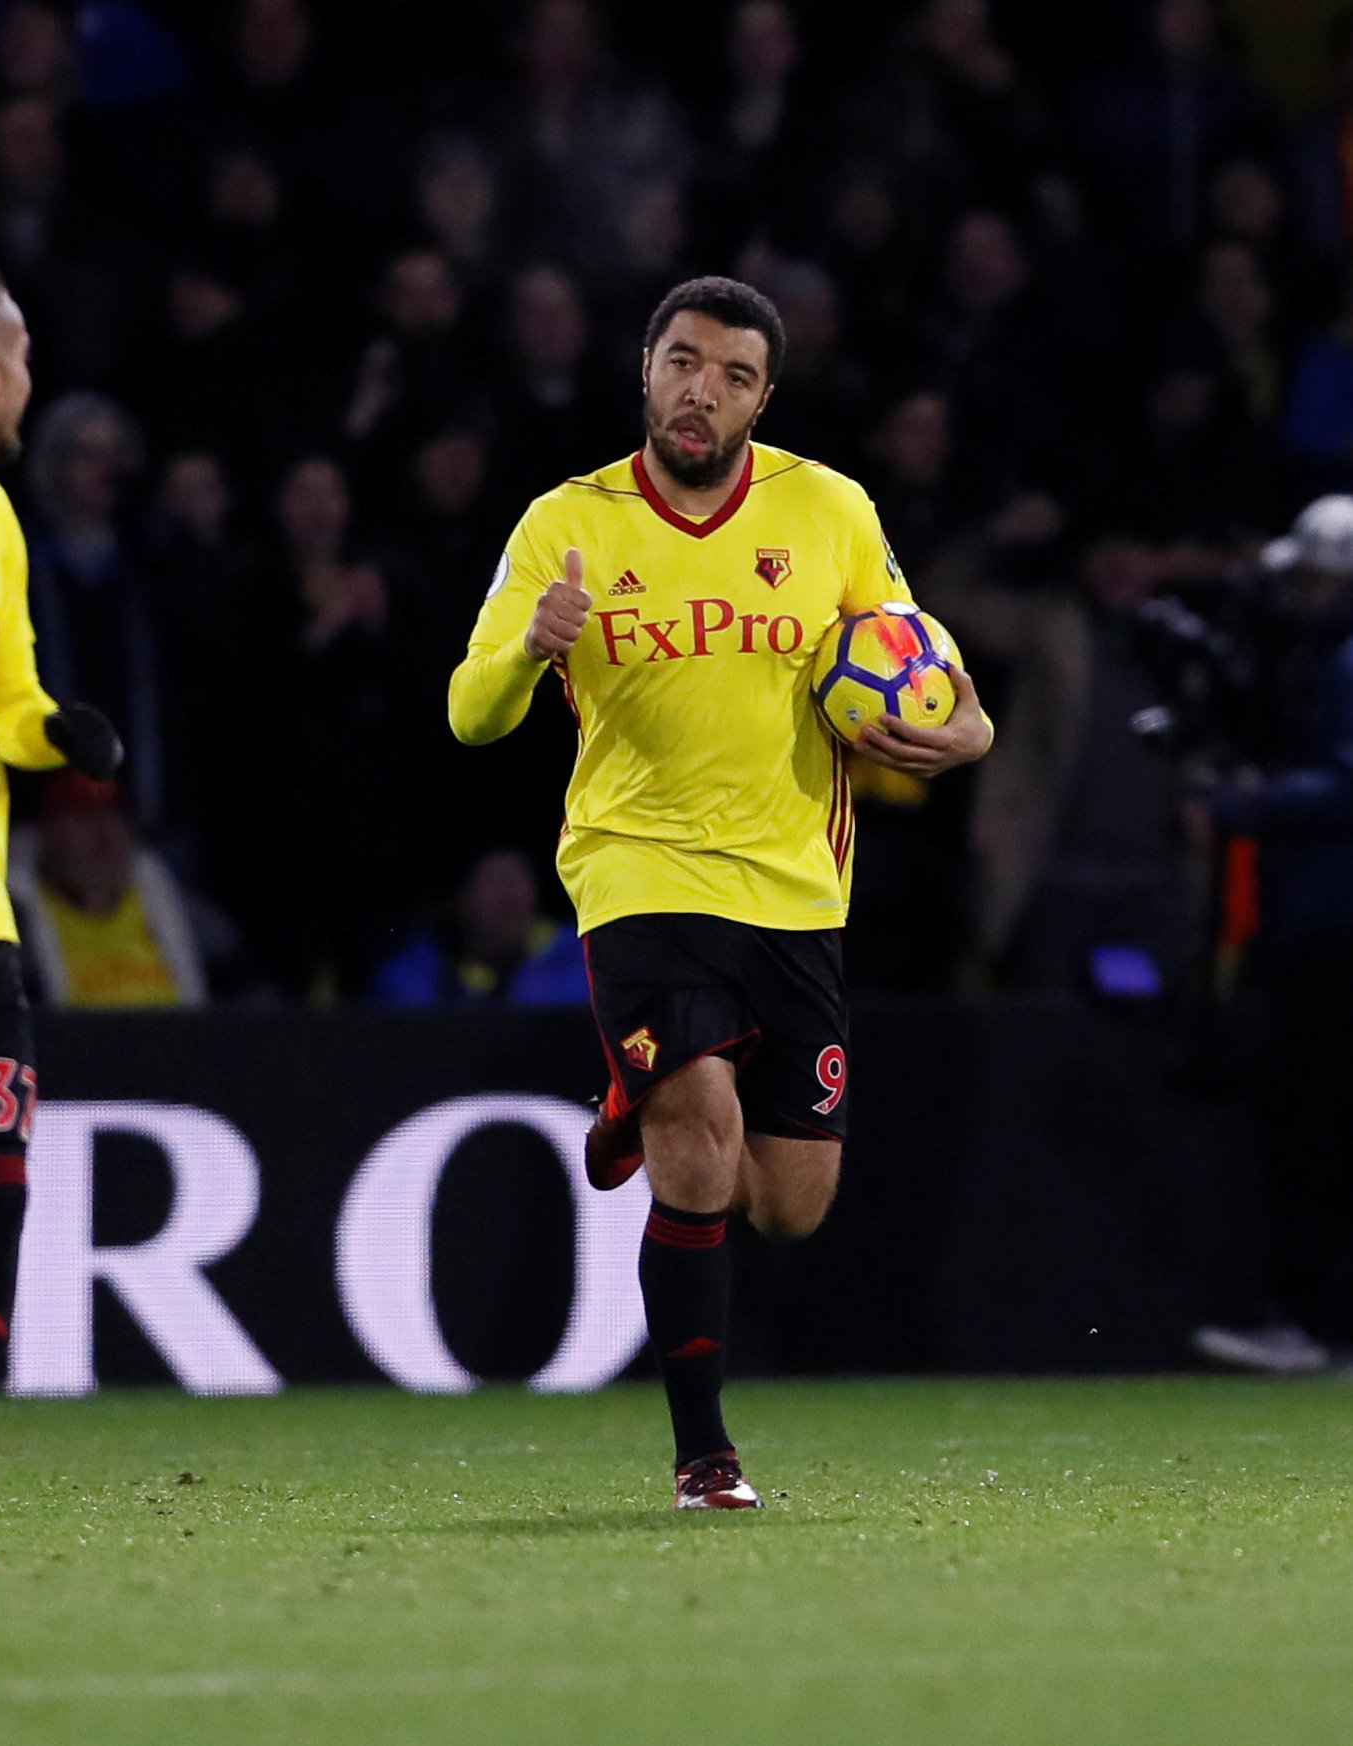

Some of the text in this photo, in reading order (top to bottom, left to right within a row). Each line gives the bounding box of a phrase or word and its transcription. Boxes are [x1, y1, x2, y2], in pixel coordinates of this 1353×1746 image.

[608, 584, 646, 596] adidas
[594, 597, 804, 667] FxPro
[812, 1044, 847, 1115] 9
